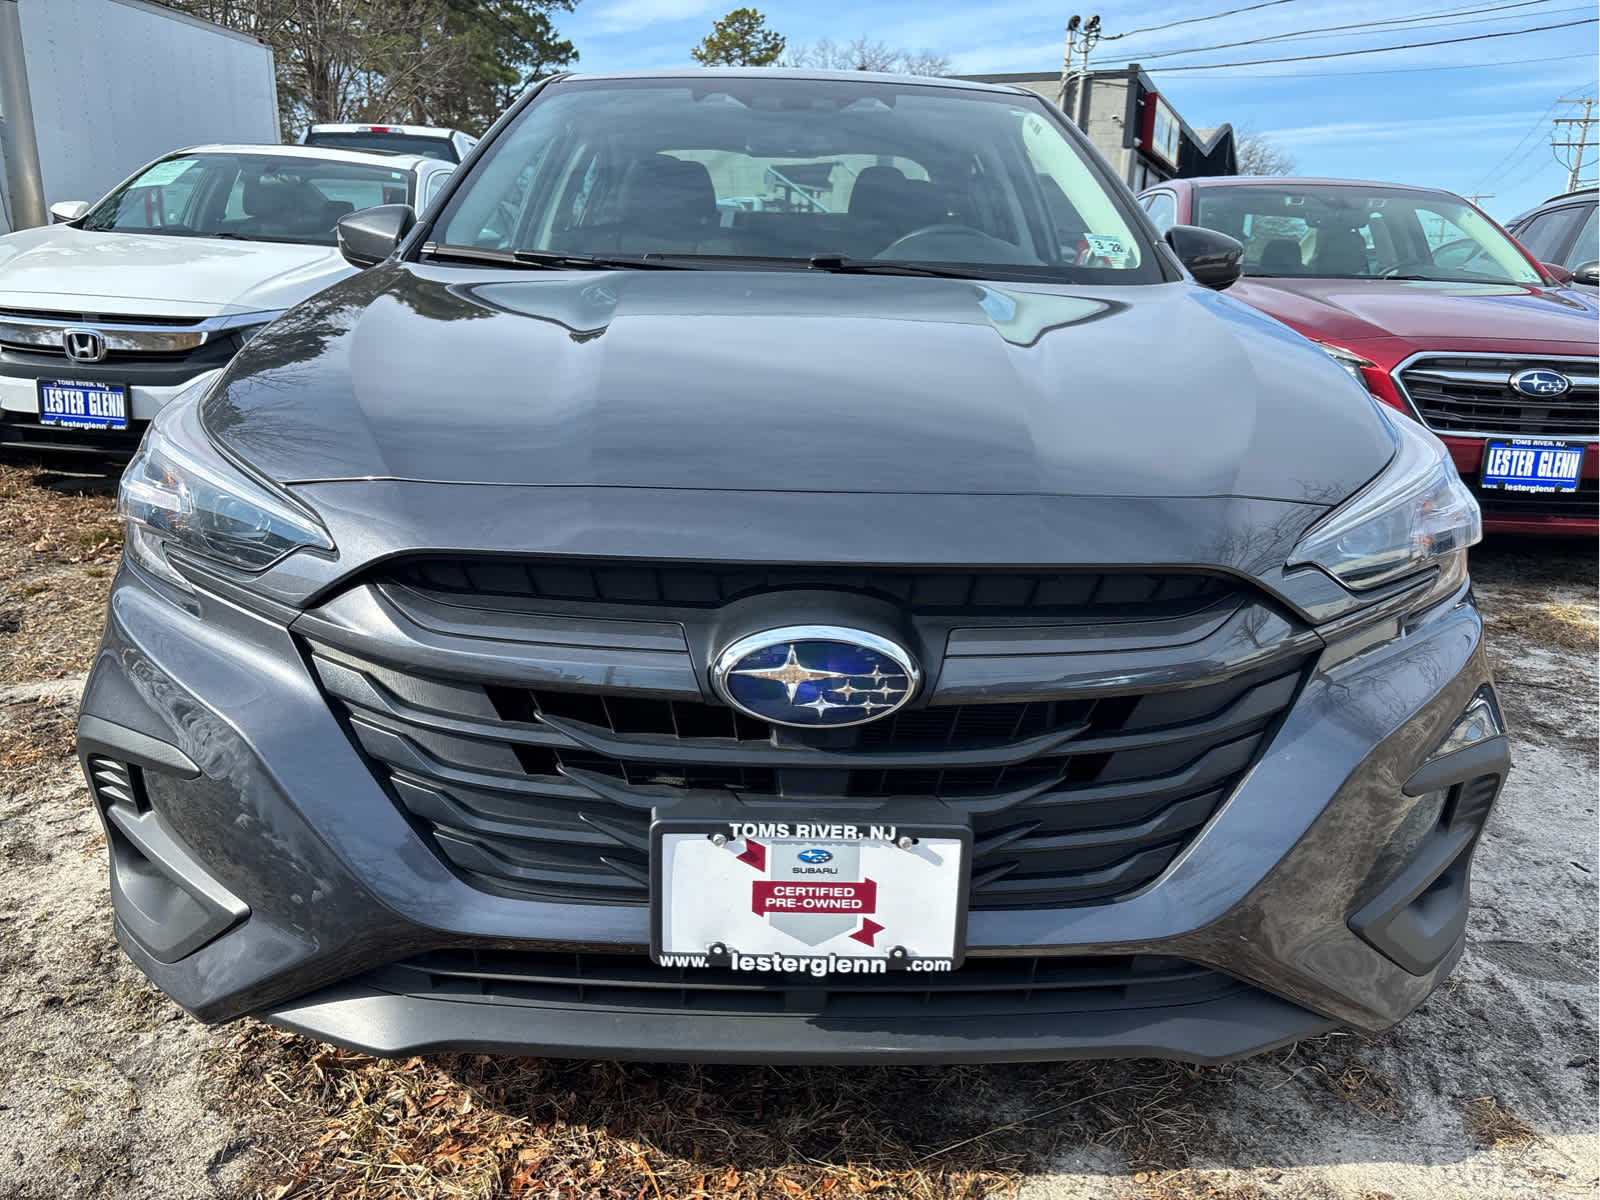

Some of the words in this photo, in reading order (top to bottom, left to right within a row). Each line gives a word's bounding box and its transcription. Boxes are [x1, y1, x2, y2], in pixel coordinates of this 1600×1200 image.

[43, 389, 85, 415] LESTER
[88, 392, 125, 418] GLENN
[60, 420, 107, 430] lesterglenn
[1486, 449, 1536, 476] LESTER
[1537, 452, 1580, 478] GLENN
[1504, 483, 1556, 493] lesterglenn
[729, 823, 790, 838] TOMS
[796, 824, 864, 840] RIVER,
[870, 825, 897, 841] NJ
[792, 867, 838, 875] SUBARU
[773, 886, 855, 897] CERTIFIED
[765, 897, 862, 909] PRE-OWNED
[659, 953, 710, 968] www.
[731, 952, 887, 977] lesterglenn
[905, 957, 952, 972] .com
